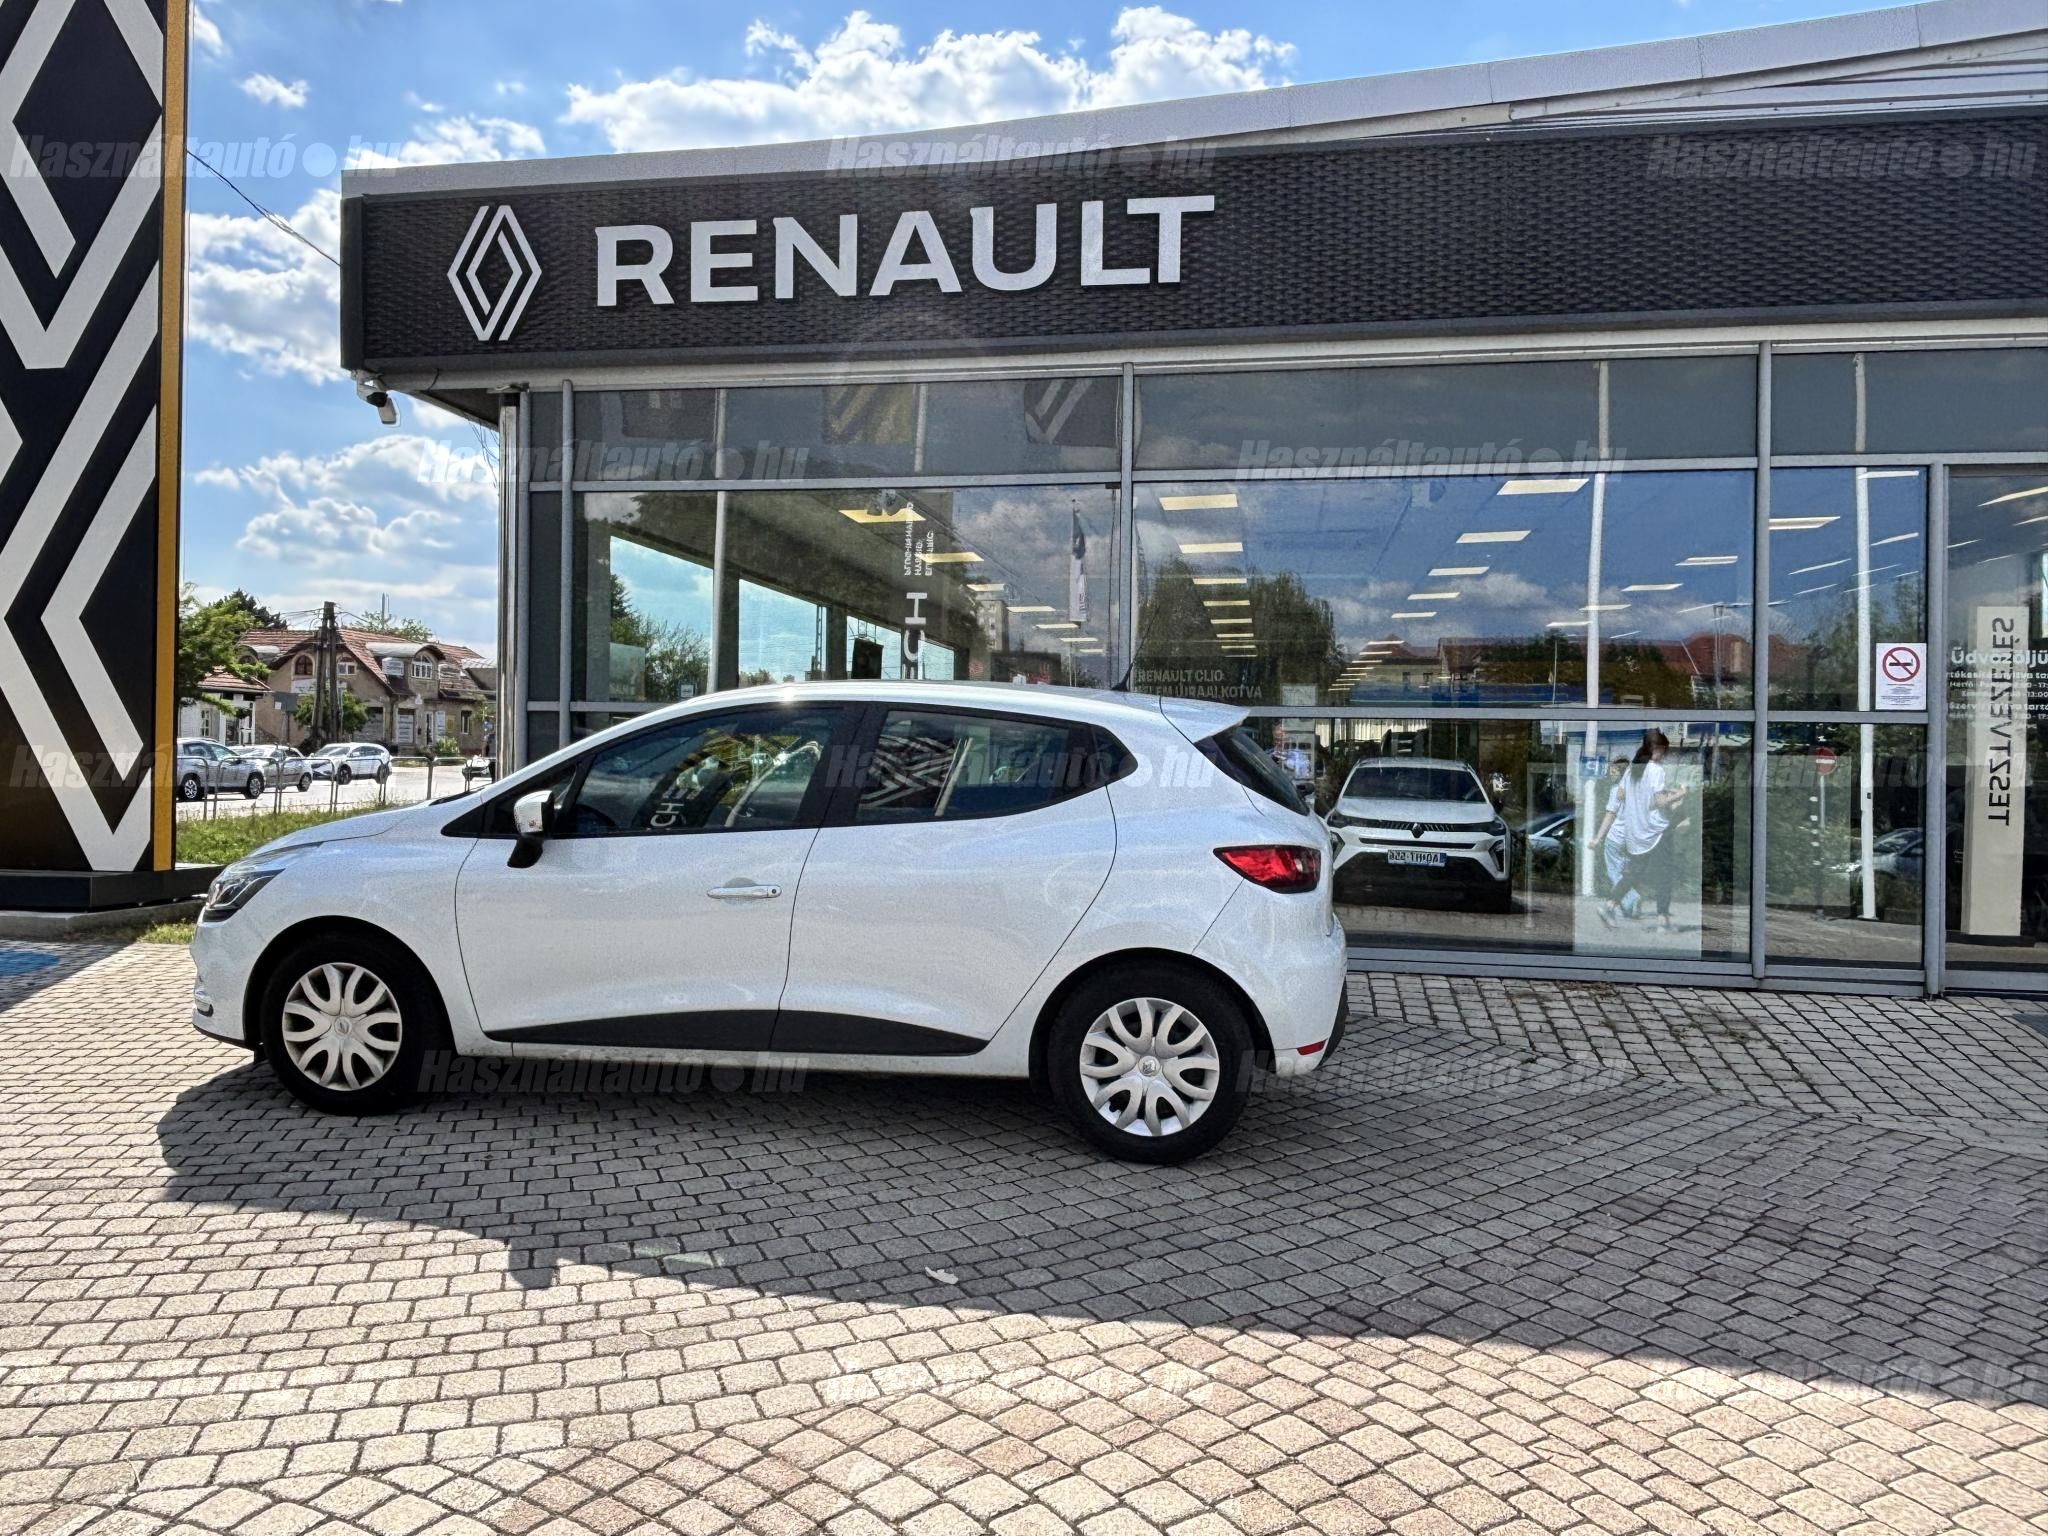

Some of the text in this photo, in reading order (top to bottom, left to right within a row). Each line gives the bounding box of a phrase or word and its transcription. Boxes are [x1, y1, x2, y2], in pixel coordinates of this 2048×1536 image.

[595, 194, 1215, 308] RENAULT
[1138, 668, 1223, 683] RENAULT CLIO
